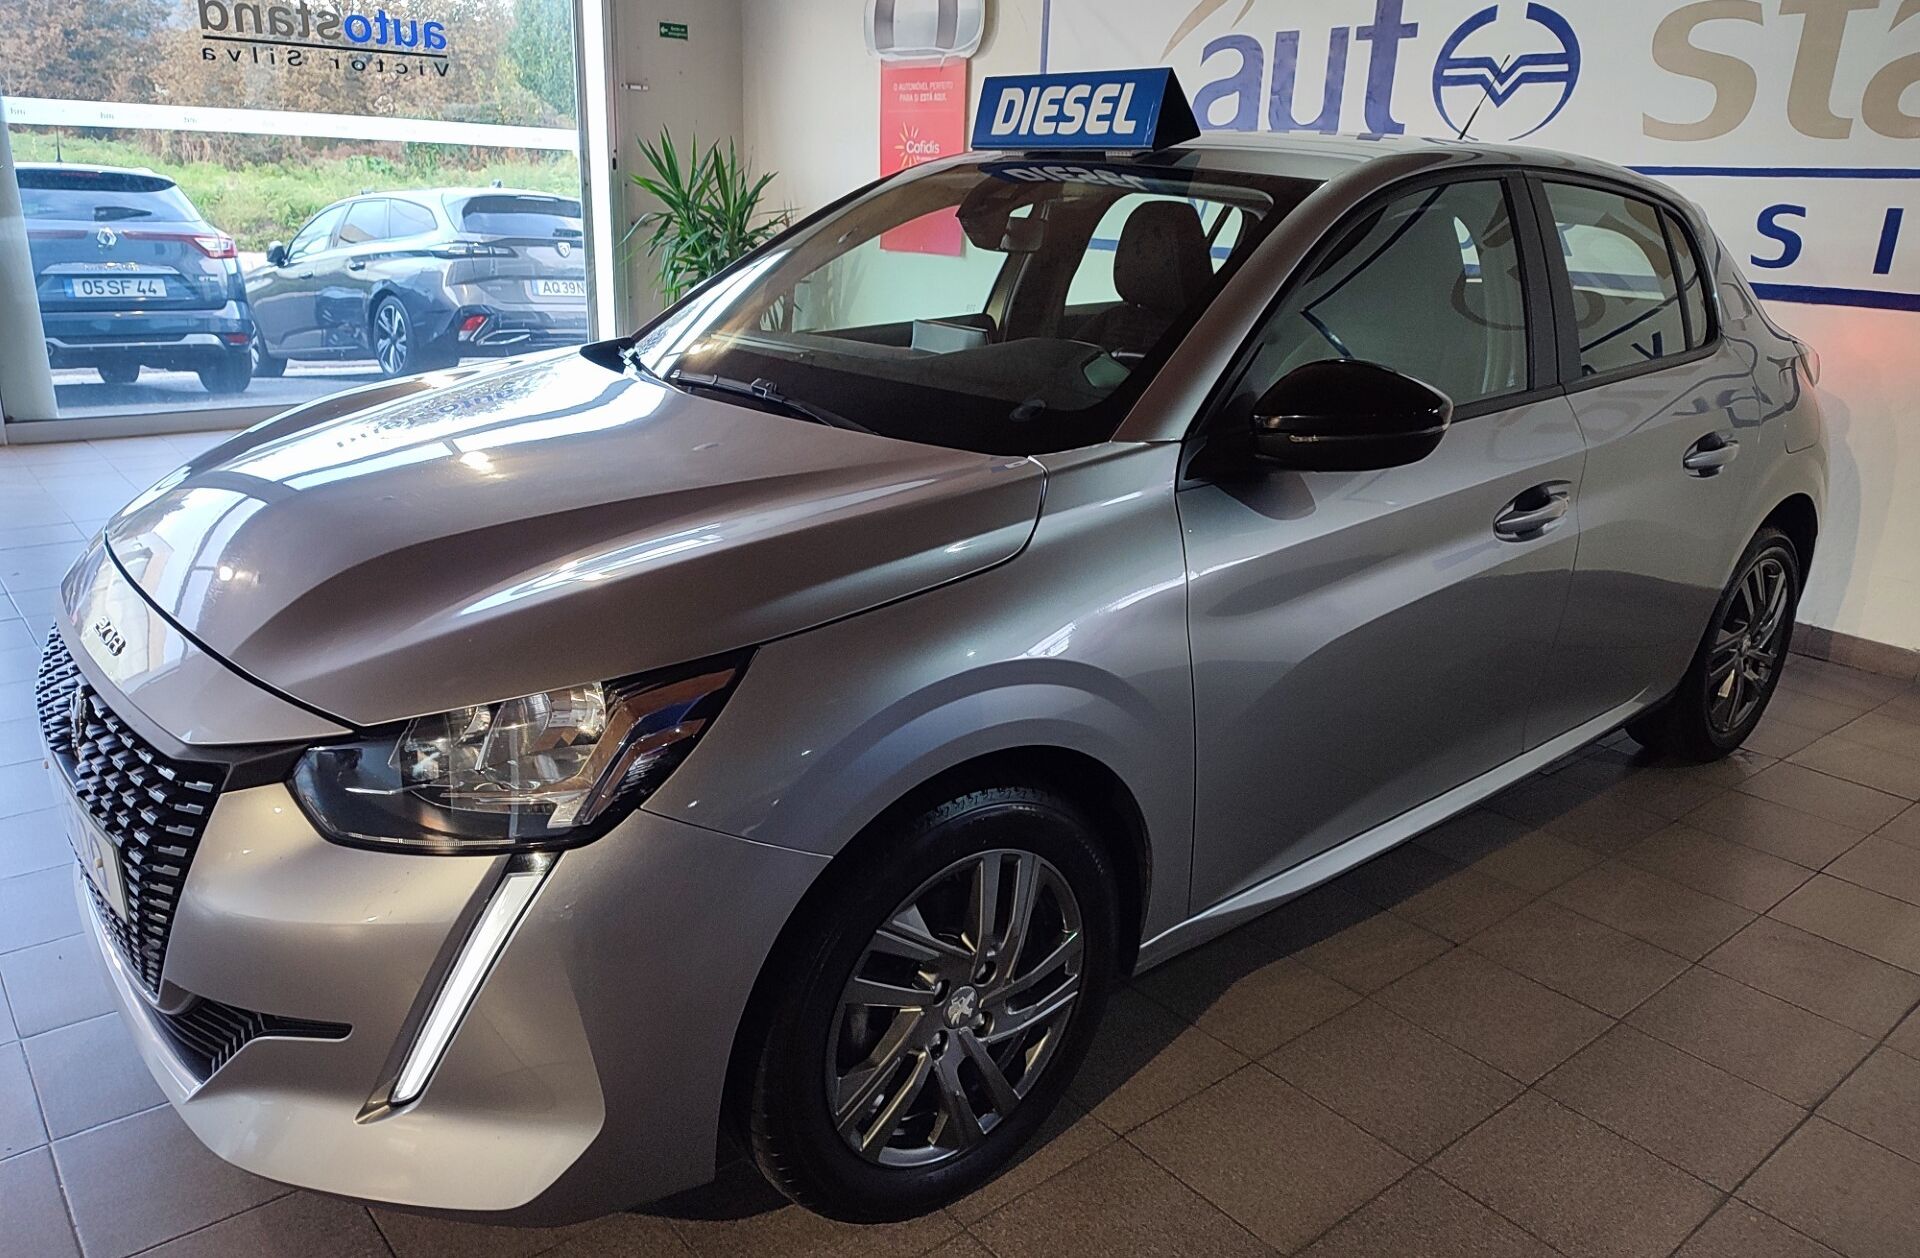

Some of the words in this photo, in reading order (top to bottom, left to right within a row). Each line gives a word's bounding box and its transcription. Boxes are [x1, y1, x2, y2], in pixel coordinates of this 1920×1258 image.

[991, 82, 1136, 135] DIESEL
[906, 140, 940, 154] Cofidis
[82, 280, 104, 295] 05
[108, 280, 131, 295] SF
[137, 280, 157, 295] 44
[543, 281, 561, 294] AQ
[563, 281, 576, 294] 39
[93, 616, 126, 657] 208
